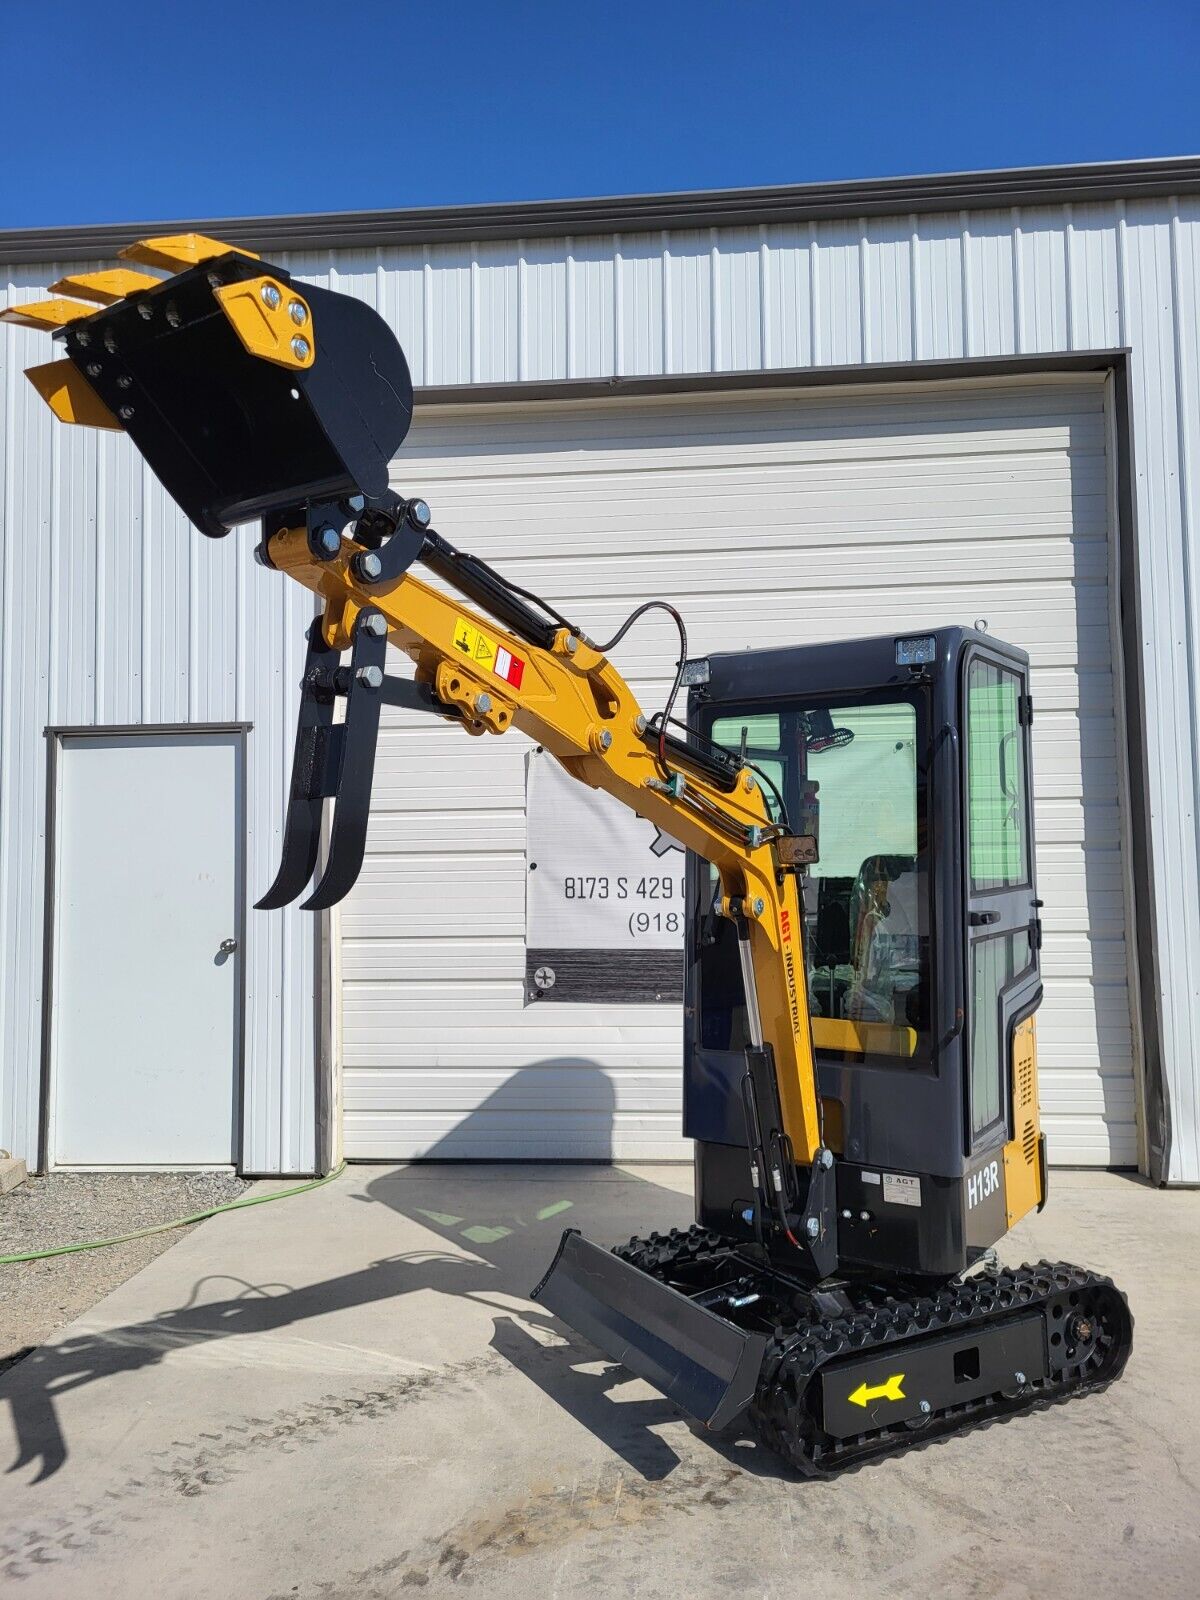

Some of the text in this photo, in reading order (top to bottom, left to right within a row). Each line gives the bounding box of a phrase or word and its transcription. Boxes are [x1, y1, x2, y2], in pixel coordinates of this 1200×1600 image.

[565, 877, 609, 899] 8173
[617, 877, 628, 899] S
[636, 877, 673, 899] 429
[780, 910, 792, 943] AGT
[785, 950, 800, 1036] INDUSTRIAL
[896, 1178, 915, 1186] AGT
[967, 1160, 999, 1209] H13R
